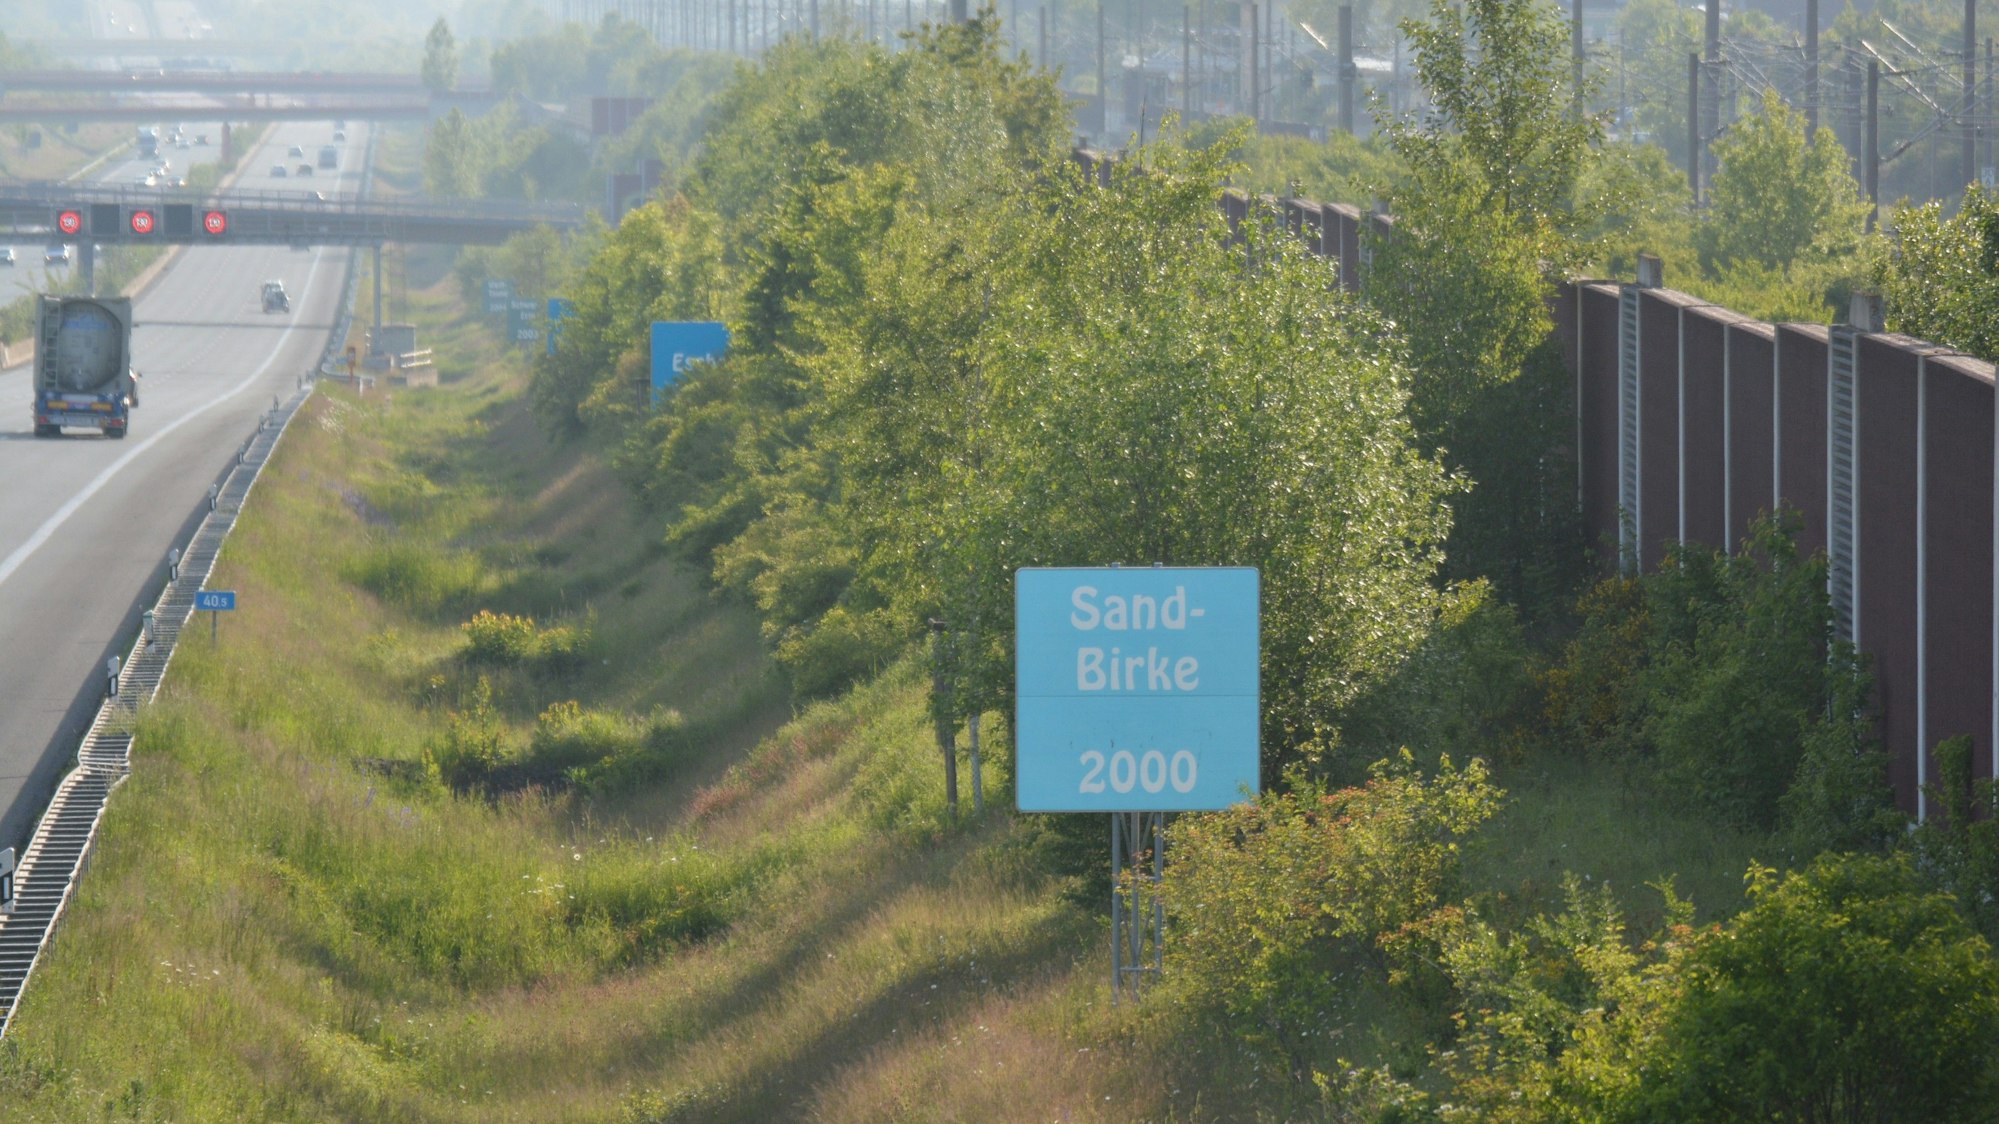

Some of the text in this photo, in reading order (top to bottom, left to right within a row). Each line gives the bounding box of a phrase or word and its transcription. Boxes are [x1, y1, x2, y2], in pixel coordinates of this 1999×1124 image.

[1071, 586, 1205, 630] Sand-
[1077, 647, 1199, 690] Birke
[1078, 749, 1198, 794] 2000
